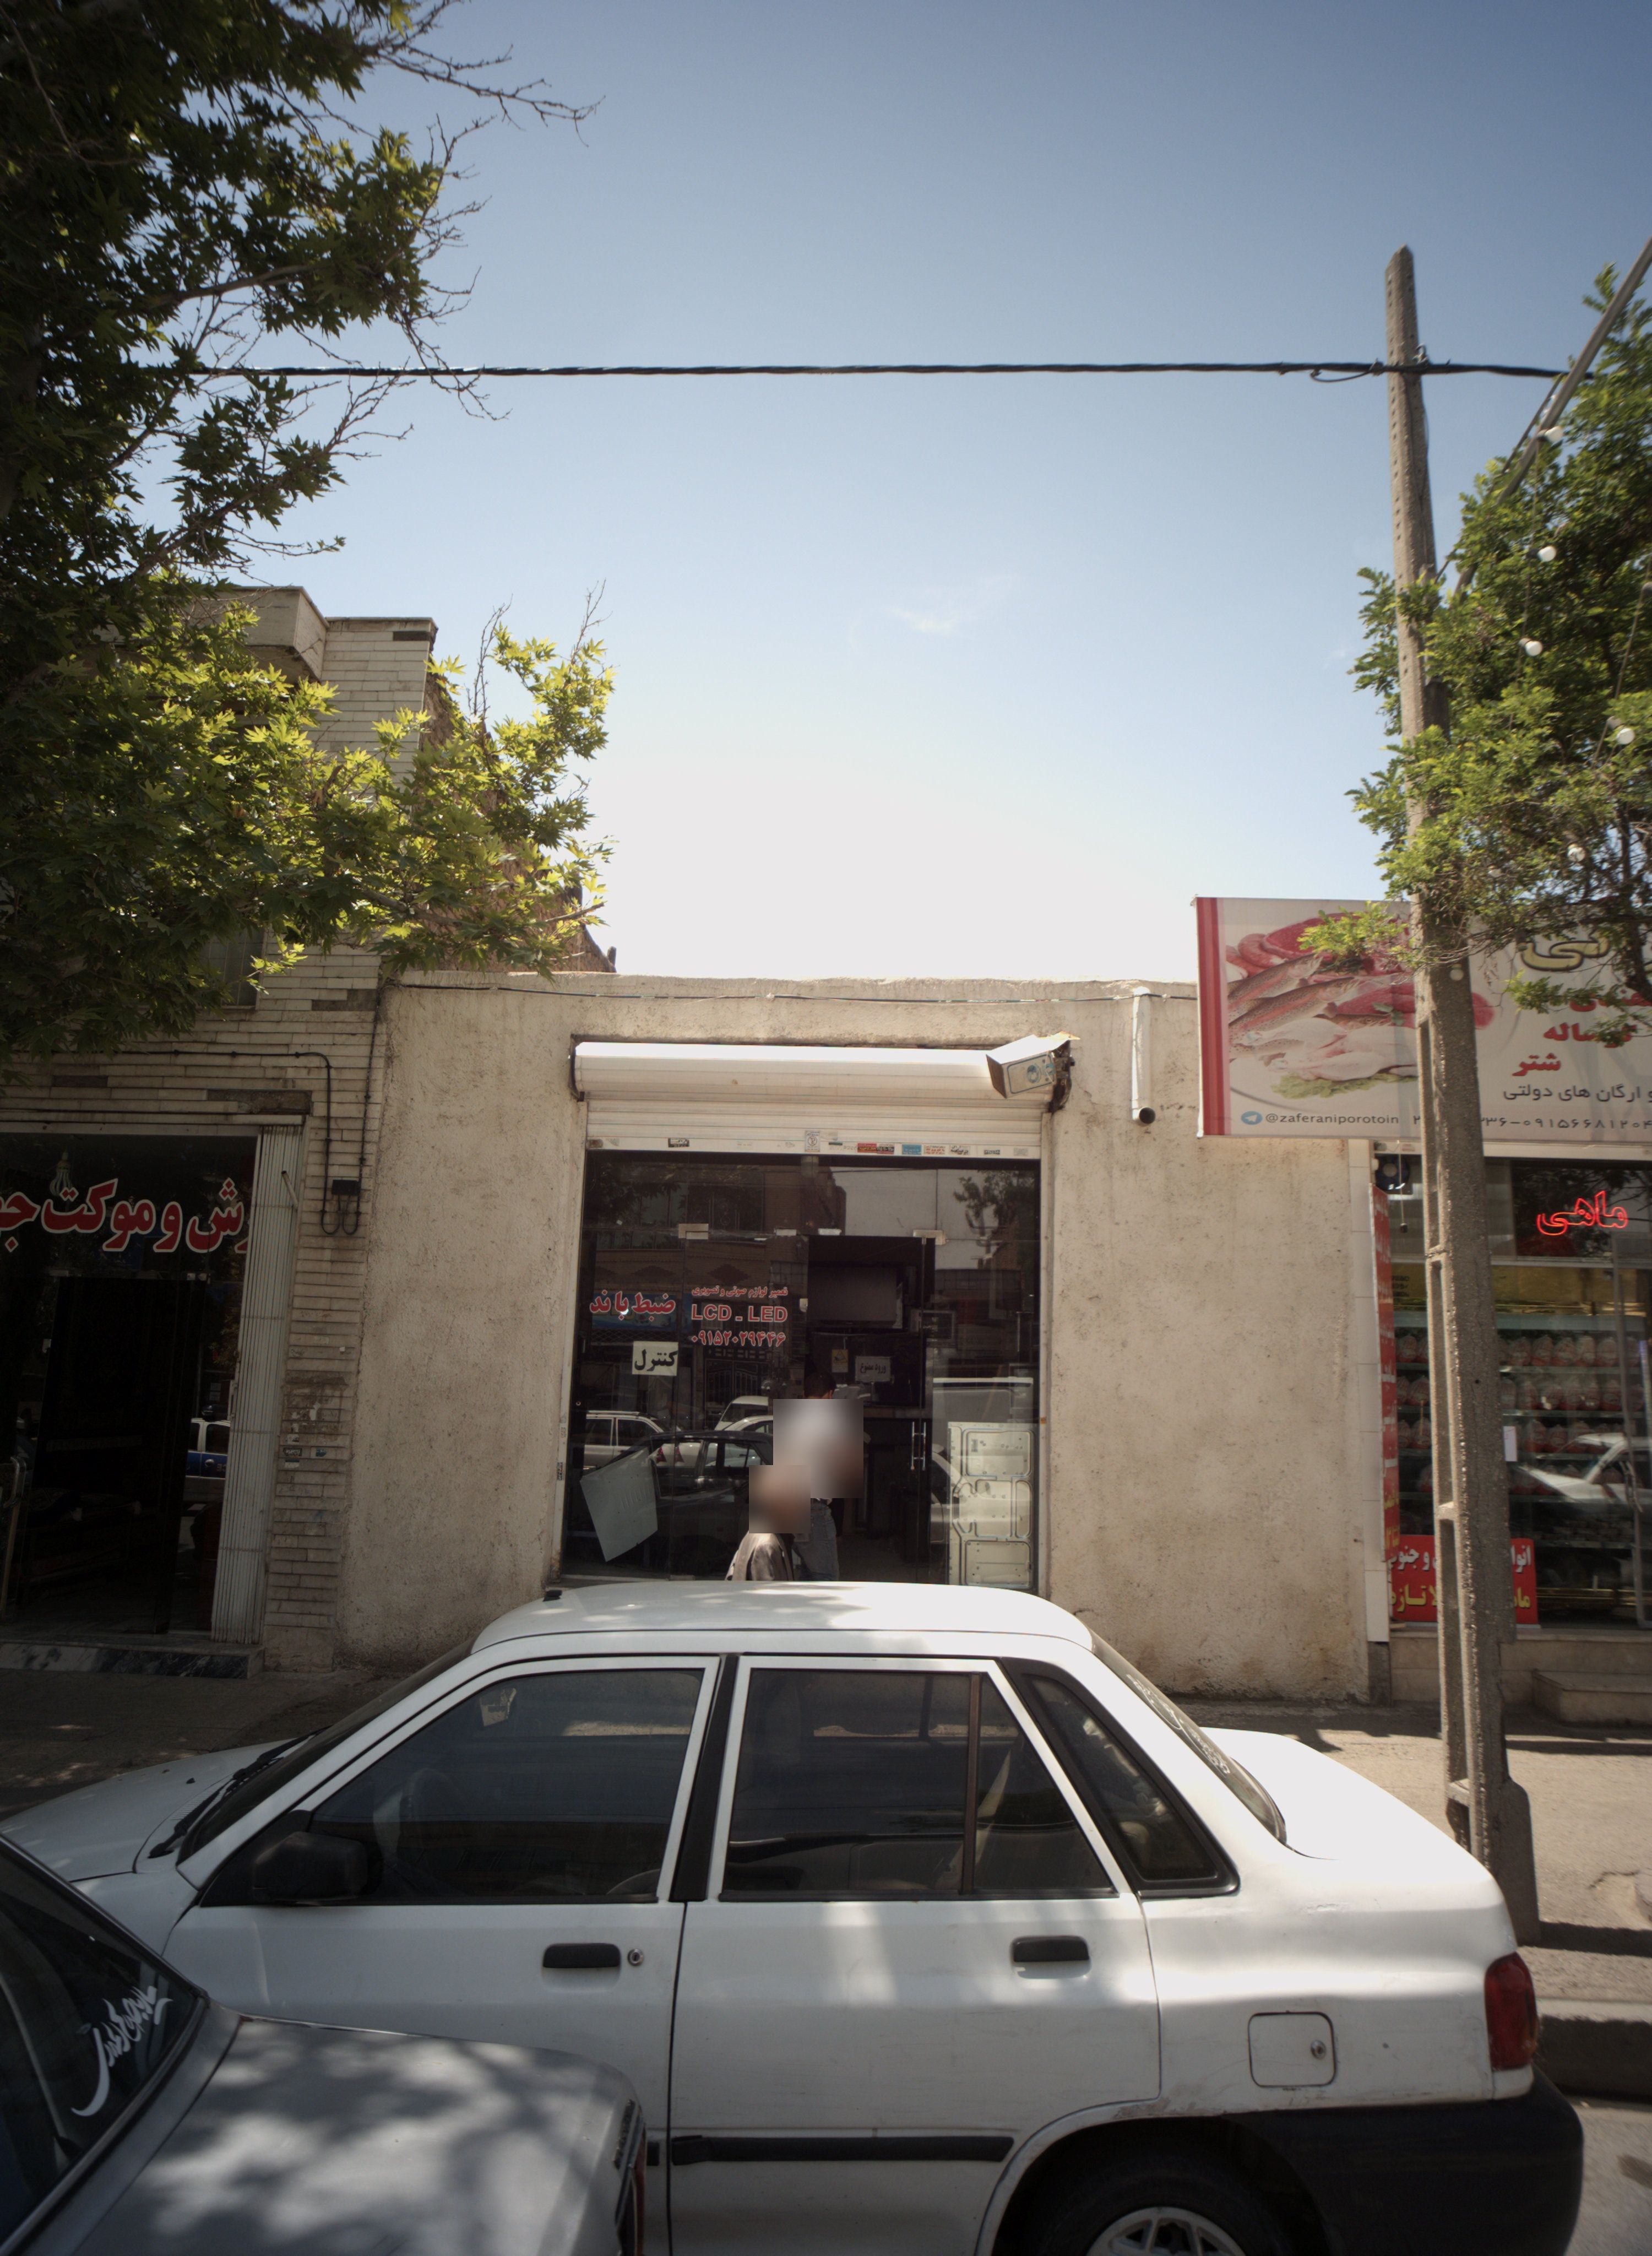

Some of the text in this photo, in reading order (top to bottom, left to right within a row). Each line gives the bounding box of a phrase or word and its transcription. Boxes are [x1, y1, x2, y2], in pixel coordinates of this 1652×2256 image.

[1512, 1053, 1562, 1077] شتر
[1503, 1084, 1552, 1101] دولتی
[1558, 1085, 1590, 1101] های
[1596, 1083, 1640, 1102] ارگان
[1265, 1113, 1399, 1125] @zaferaniporotoin
[41, 1177, 156, 1252] موکت
[1536, 1190, 1629, 1236] ماهی
[153, 1201, 183, 1252] و
[691, 1285, 789, 1298] تعمیر لوازم صوتی و تصویری
[631, 1291, 676, 1322] ضبط
[691, 1303, 732, 1321] LCD
[748, 1305, 789, 1322] LED
[634, 1348, 679, 1371] کنترل
[1510, 1544, 1531, 1574] انوا
